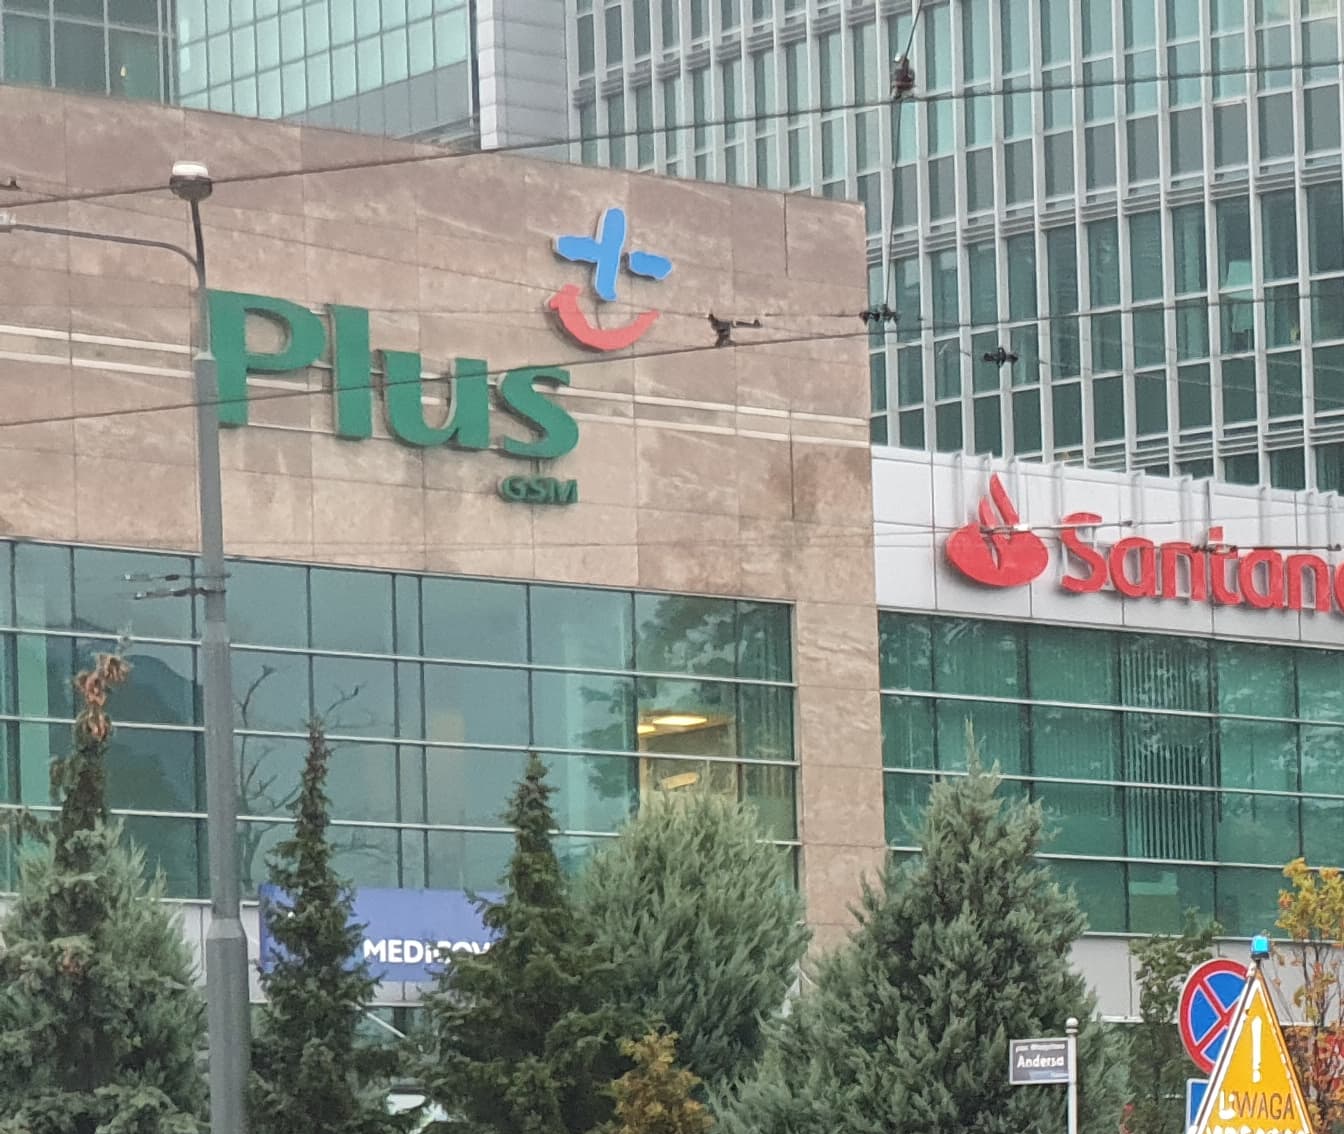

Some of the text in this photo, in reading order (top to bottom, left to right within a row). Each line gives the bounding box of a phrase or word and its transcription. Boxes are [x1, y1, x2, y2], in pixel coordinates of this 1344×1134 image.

[207, 288, 579, 459] Plus
[502, 476, 579, 504] GSM
[1017, 1054, 1065, 1068] Andersa
[1219, 1091, 1295, 1120] UWAGA
